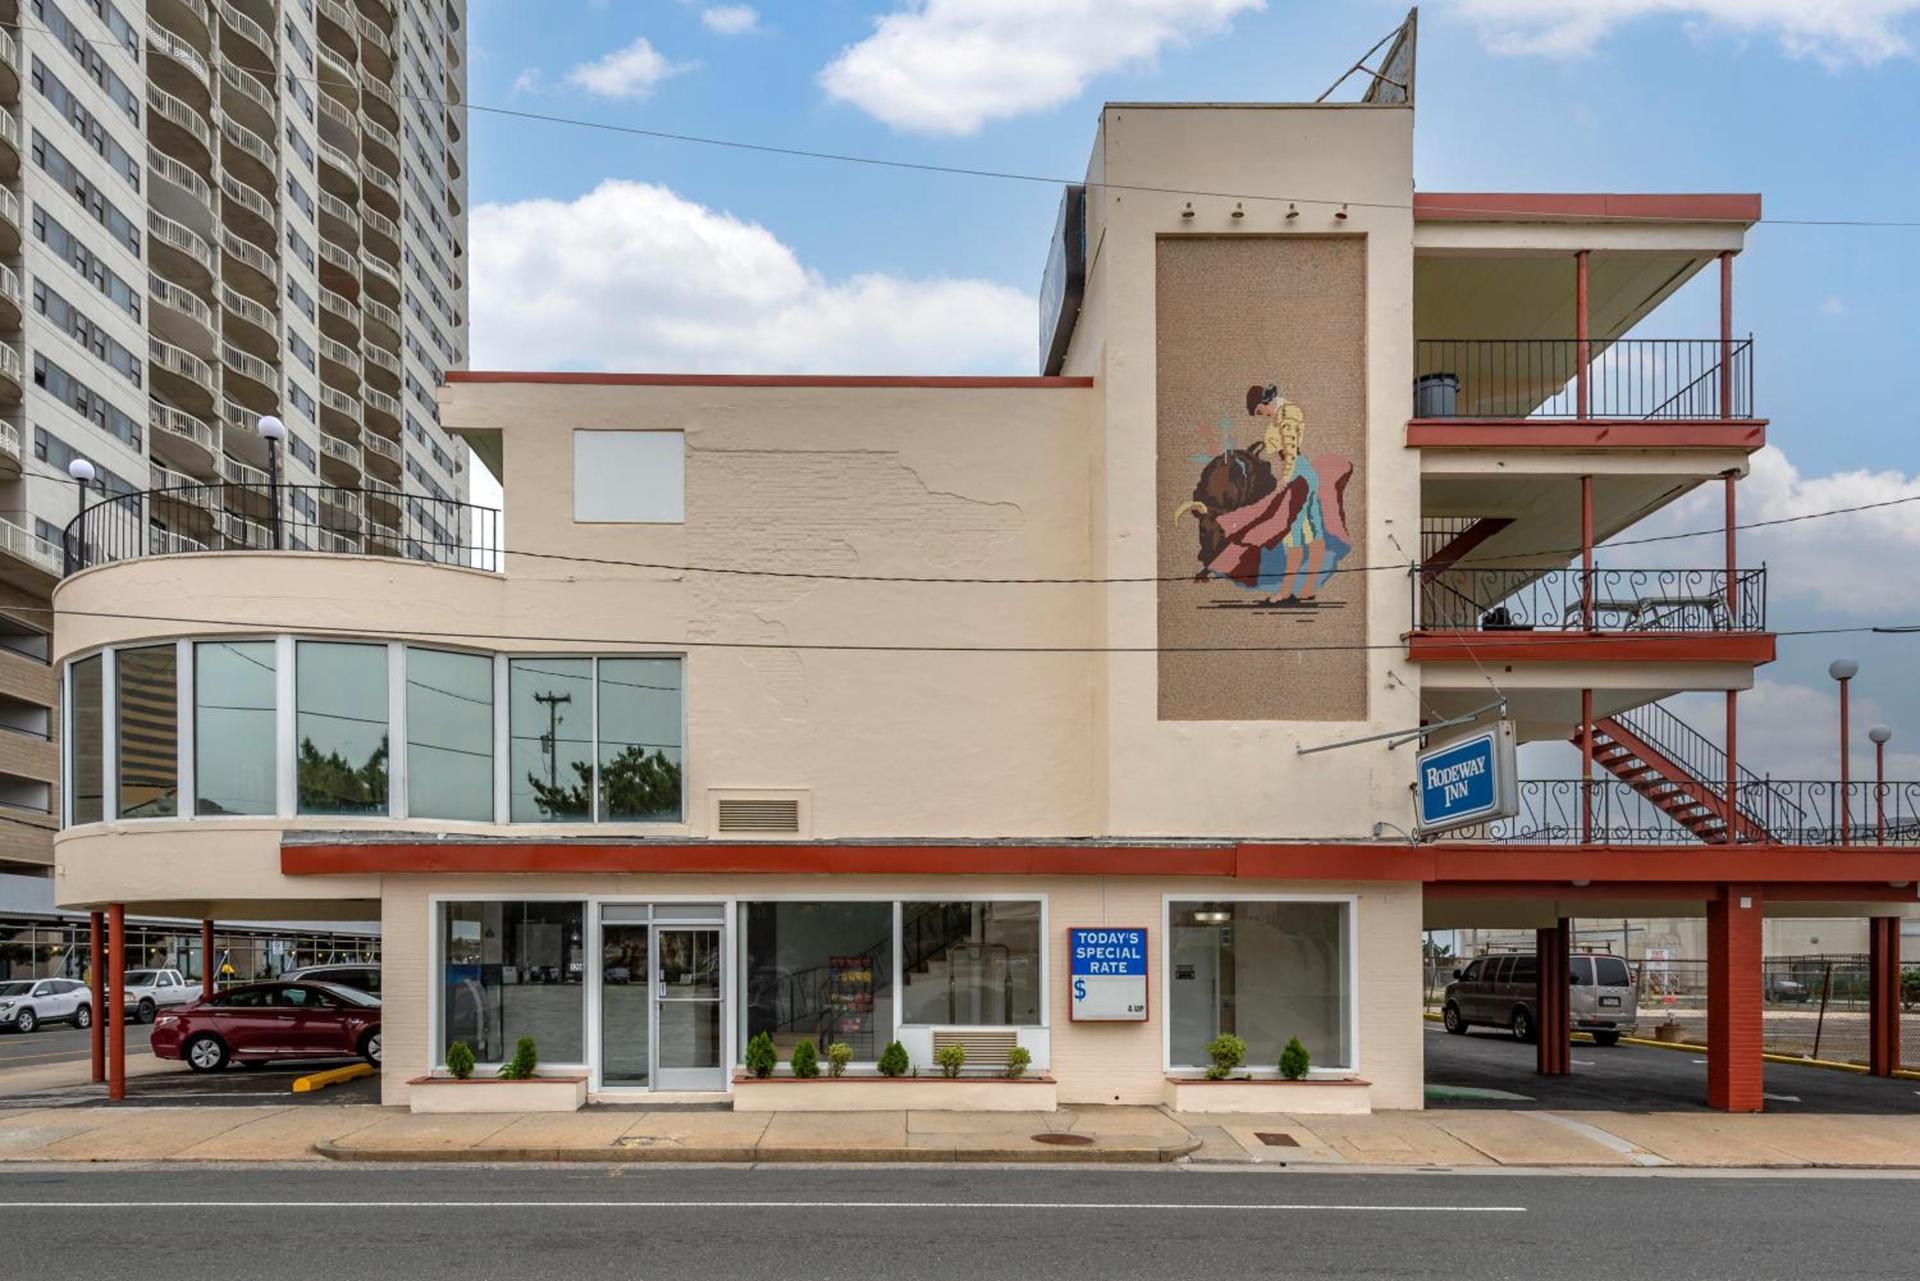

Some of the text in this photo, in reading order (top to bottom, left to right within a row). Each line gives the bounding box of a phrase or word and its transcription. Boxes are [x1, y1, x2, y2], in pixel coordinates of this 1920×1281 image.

[1426, 756, 1485, 790] RODEWAY
[1444, 780, 1468, 808] INN
[1078, 932, 1139, 944] TODAY'S
[1076, 947, 1141, 959] SPECIAL
[1090, 962, 1127, 973] RATE
[1074, 978, 1086, 1002] $
